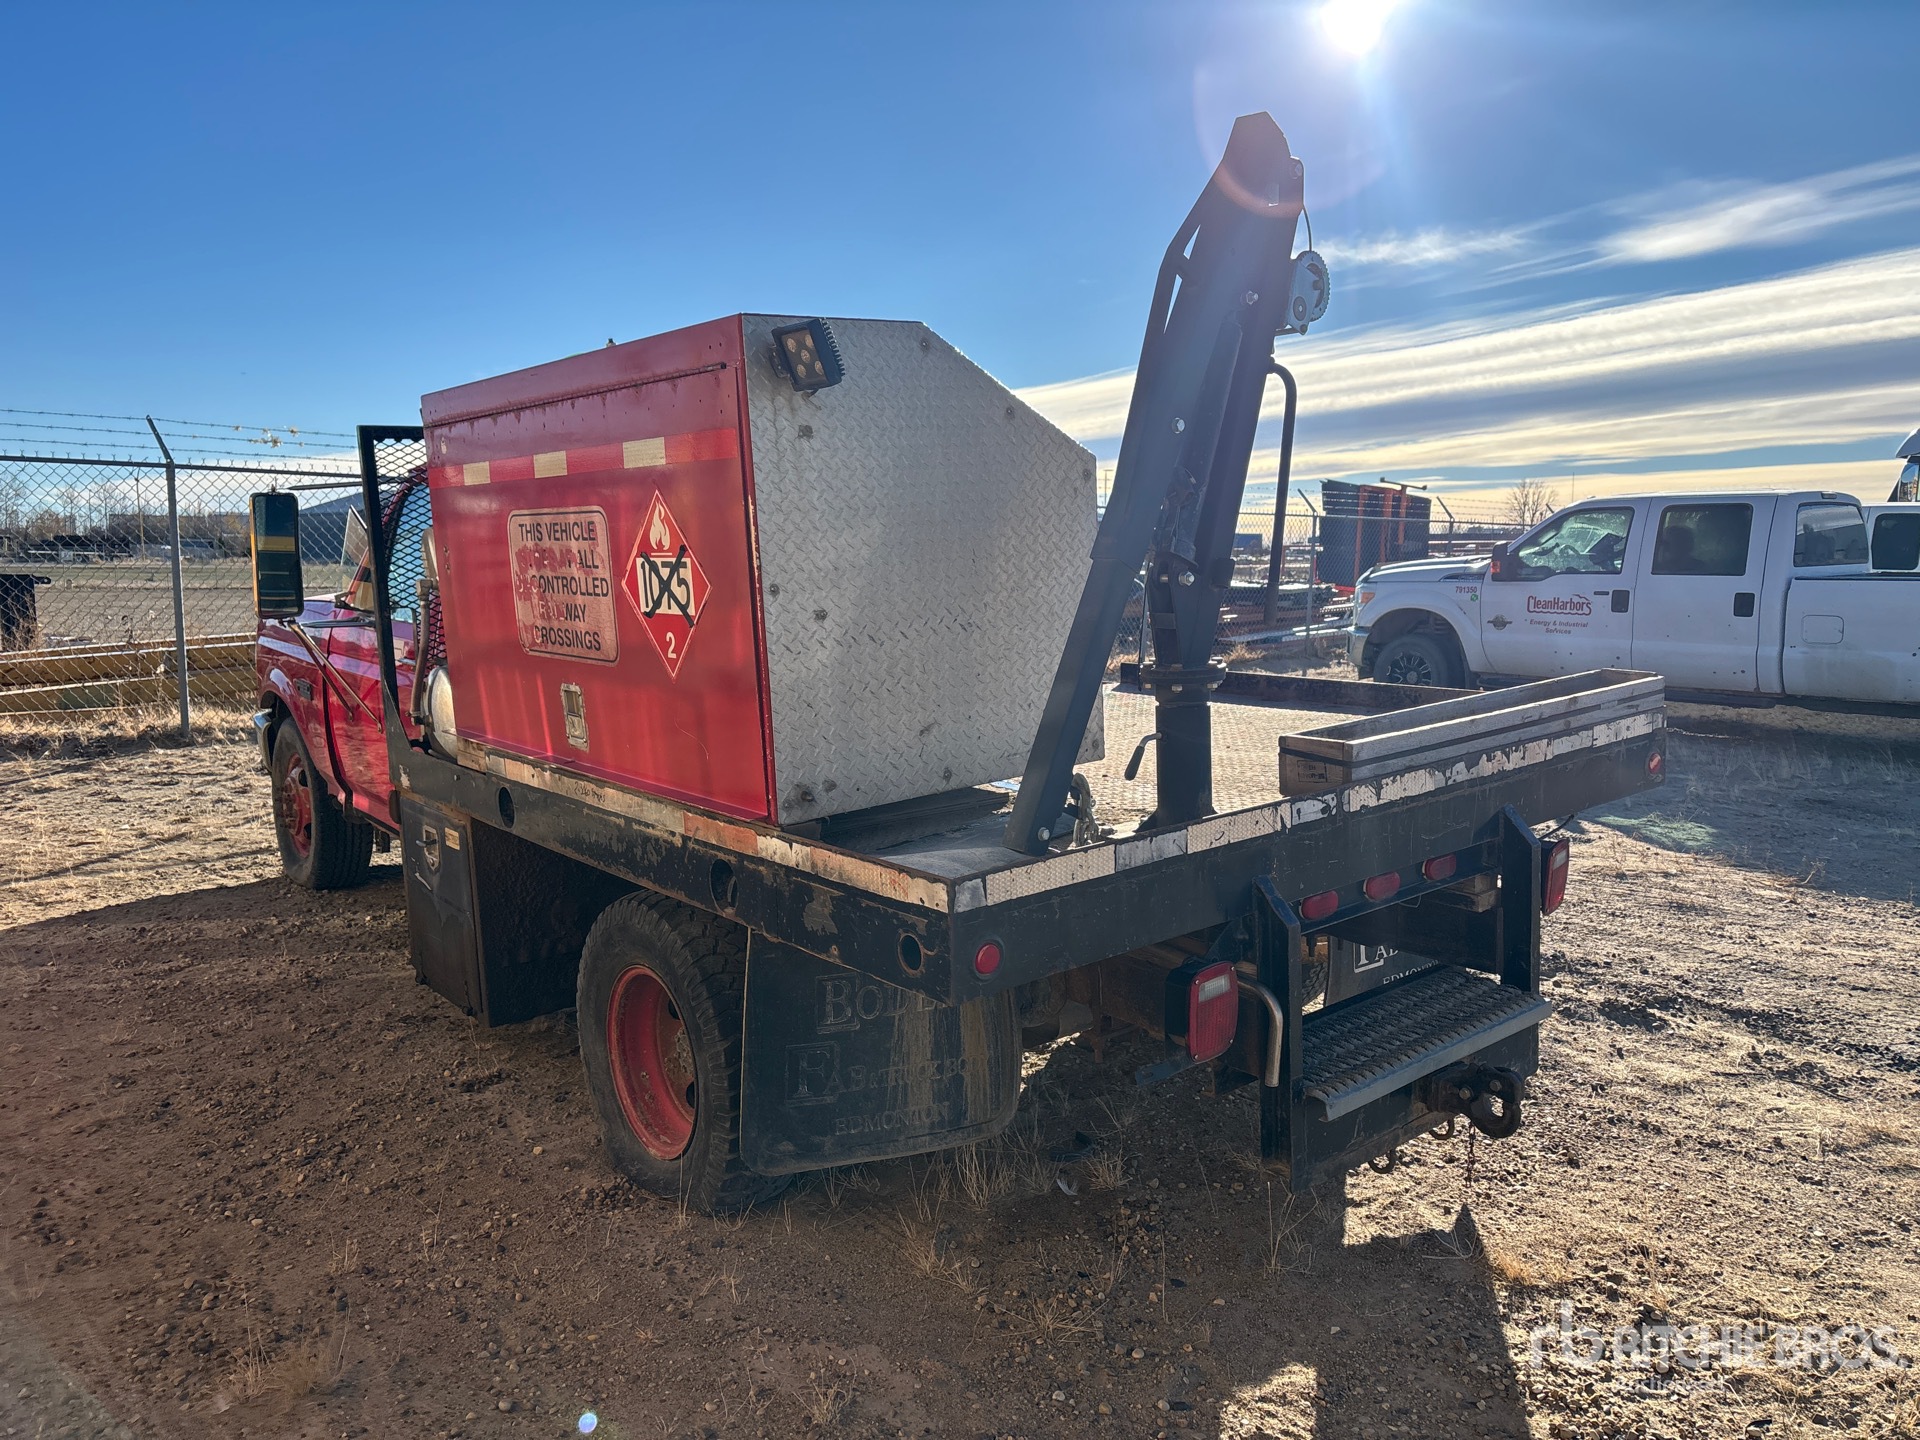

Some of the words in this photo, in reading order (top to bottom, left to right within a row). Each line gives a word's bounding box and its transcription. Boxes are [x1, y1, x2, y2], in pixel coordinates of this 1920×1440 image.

[518, 523, 543, 542] THIS
[544, 521, 596, 542] VEHICLE
[577, 549, 599, 569] ALL
[515, 573, 609, 597] CONTROLLED
[640, 560, 690, 611] 1075
[1455, 585, 1478, 594] 791350
[1530, 619, 1551, 627] Energy
[1558, 620, 1589, 628] Industrial
[1545, 627, 1572, 635] Services
[533, 625, 601, 651] CROSSINGS
[666, 632, 676, 659] 2
[834, 1102, 949, 1135] EDMONTON
